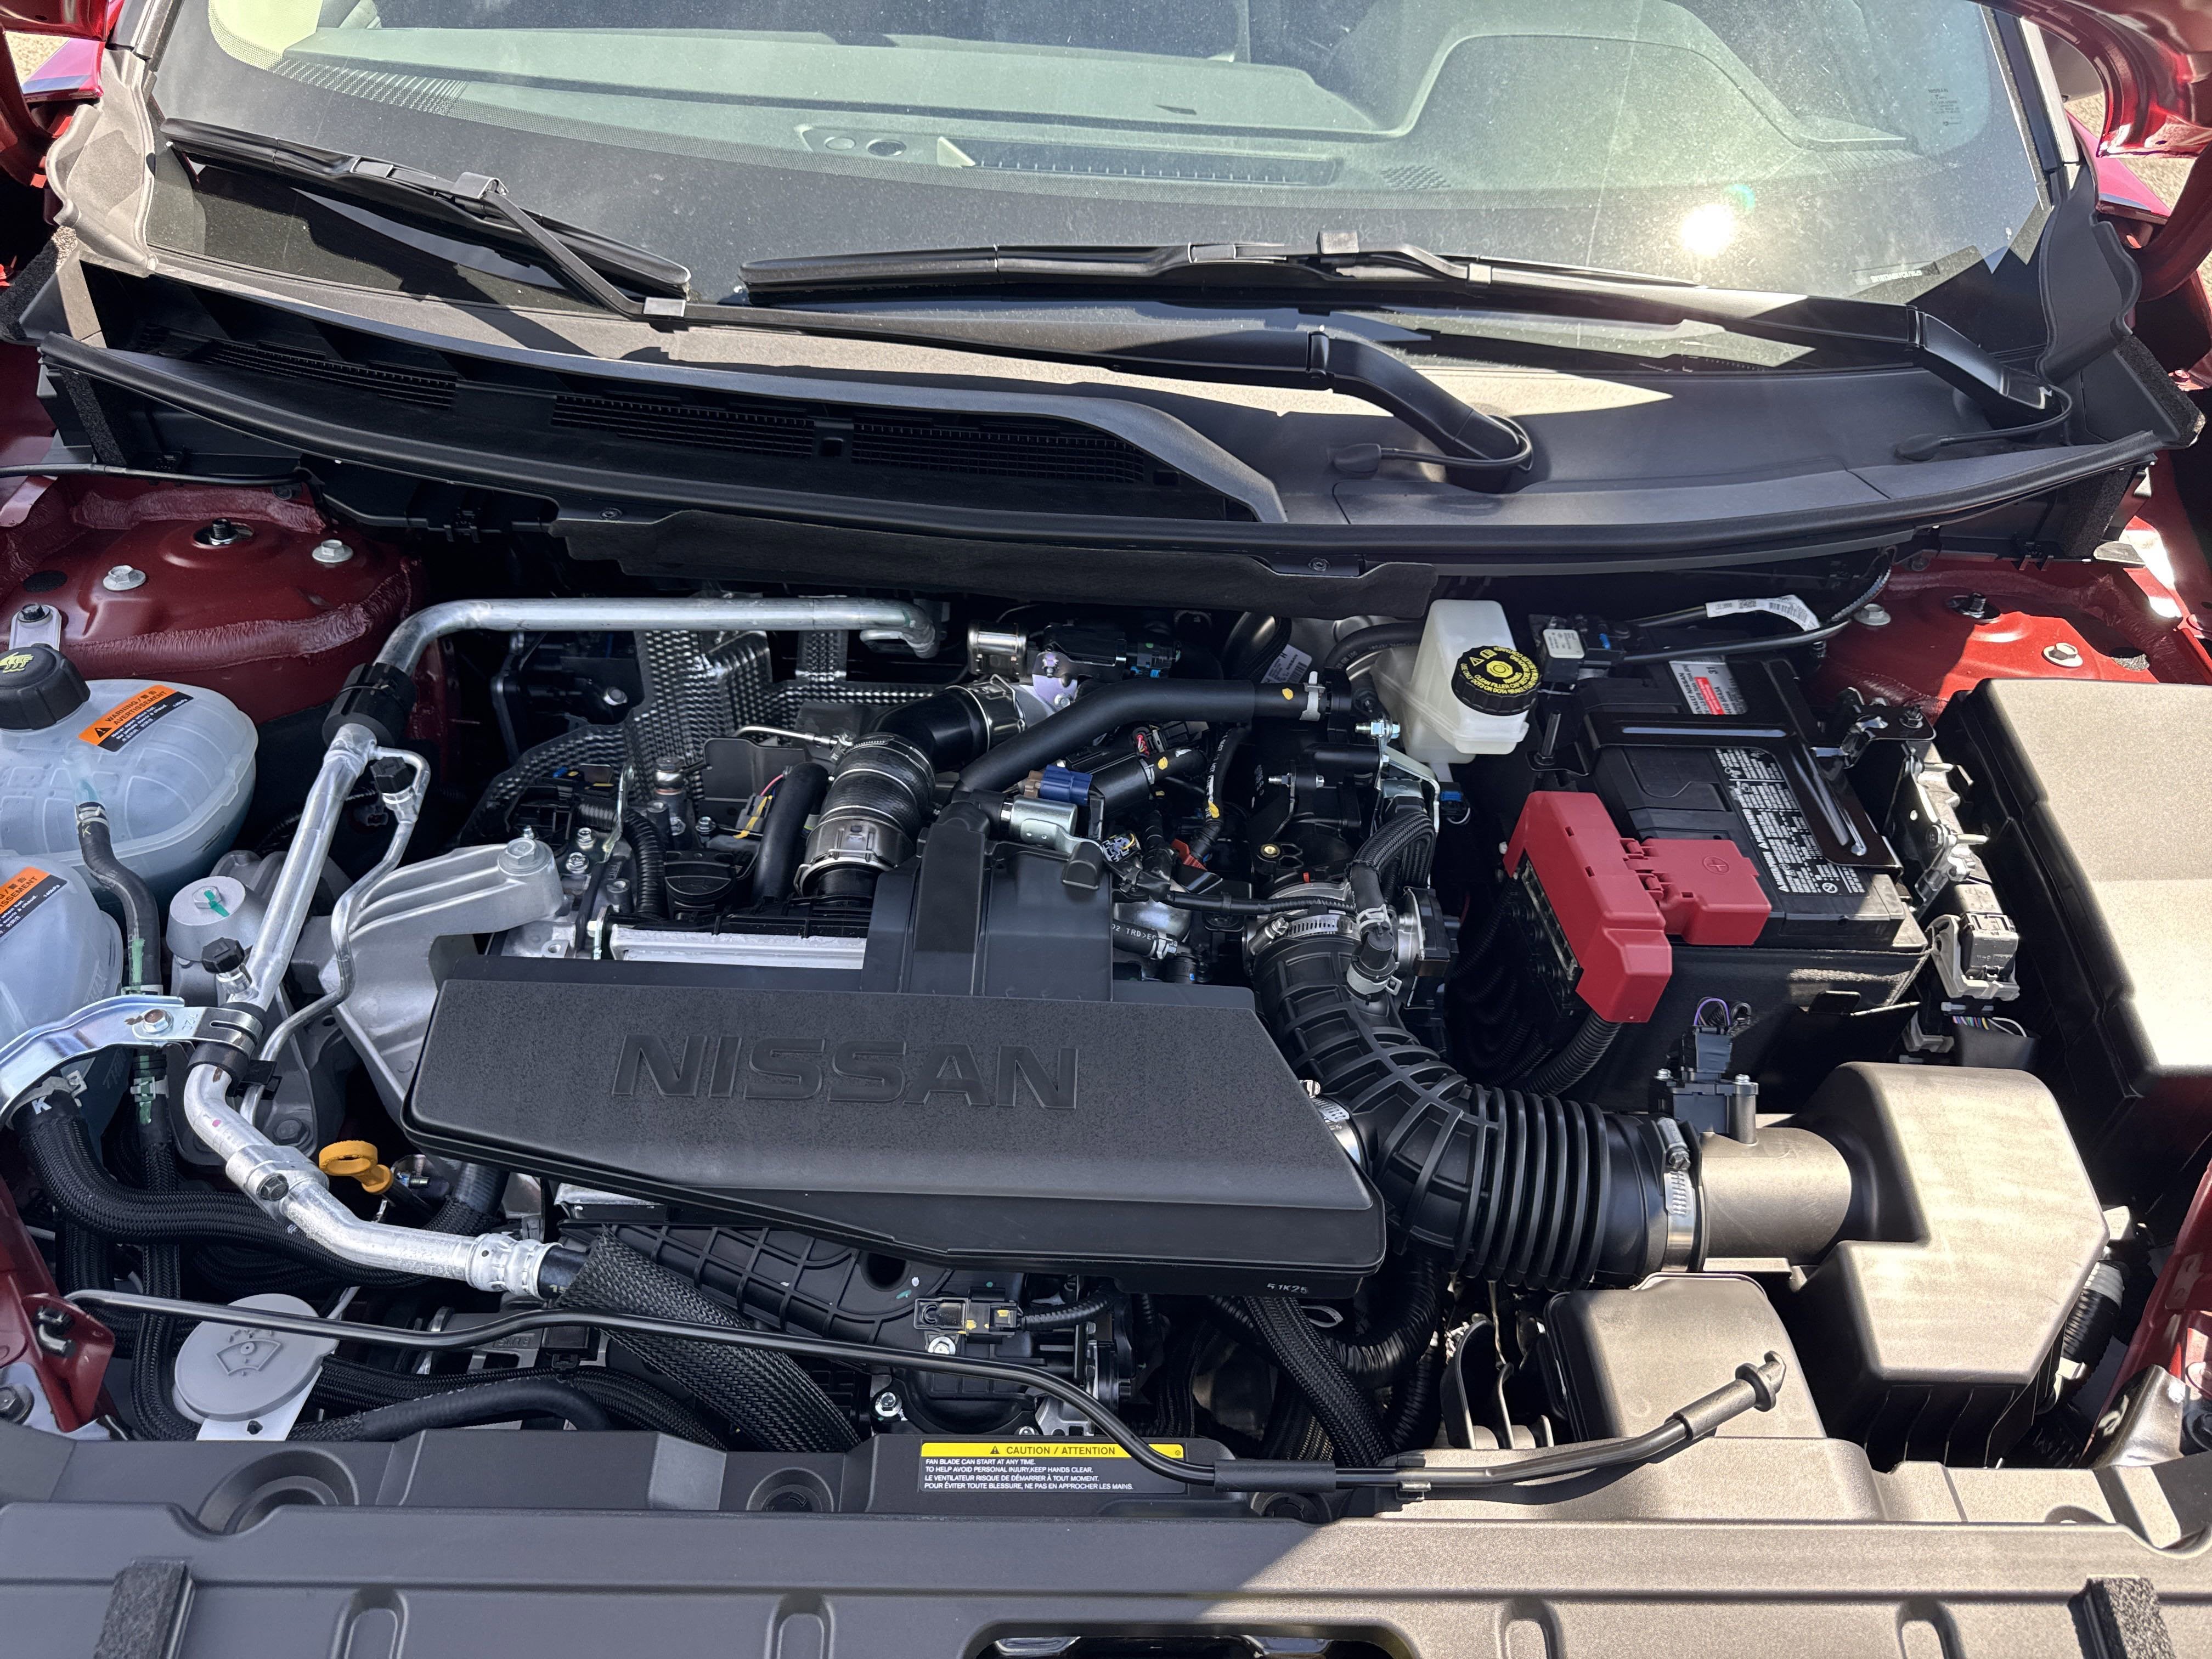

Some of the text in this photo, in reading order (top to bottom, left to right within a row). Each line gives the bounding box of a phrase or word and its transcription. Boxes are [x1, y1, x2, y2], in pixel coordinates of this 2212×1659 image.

[1678, 673, 1692, 694] NISSAN
[105, 699, 139, 723] WARNING
[113, 691, 168, 726] AVERTISSEMENT
[0, 876, 38, 911] ISSEMENT
[612, 1034, 1079, 1110] NISSAN
[31, 1096, 53, 1115] K
[1006, 1446, 1115, 1454] CAUTION / ATTENTION
